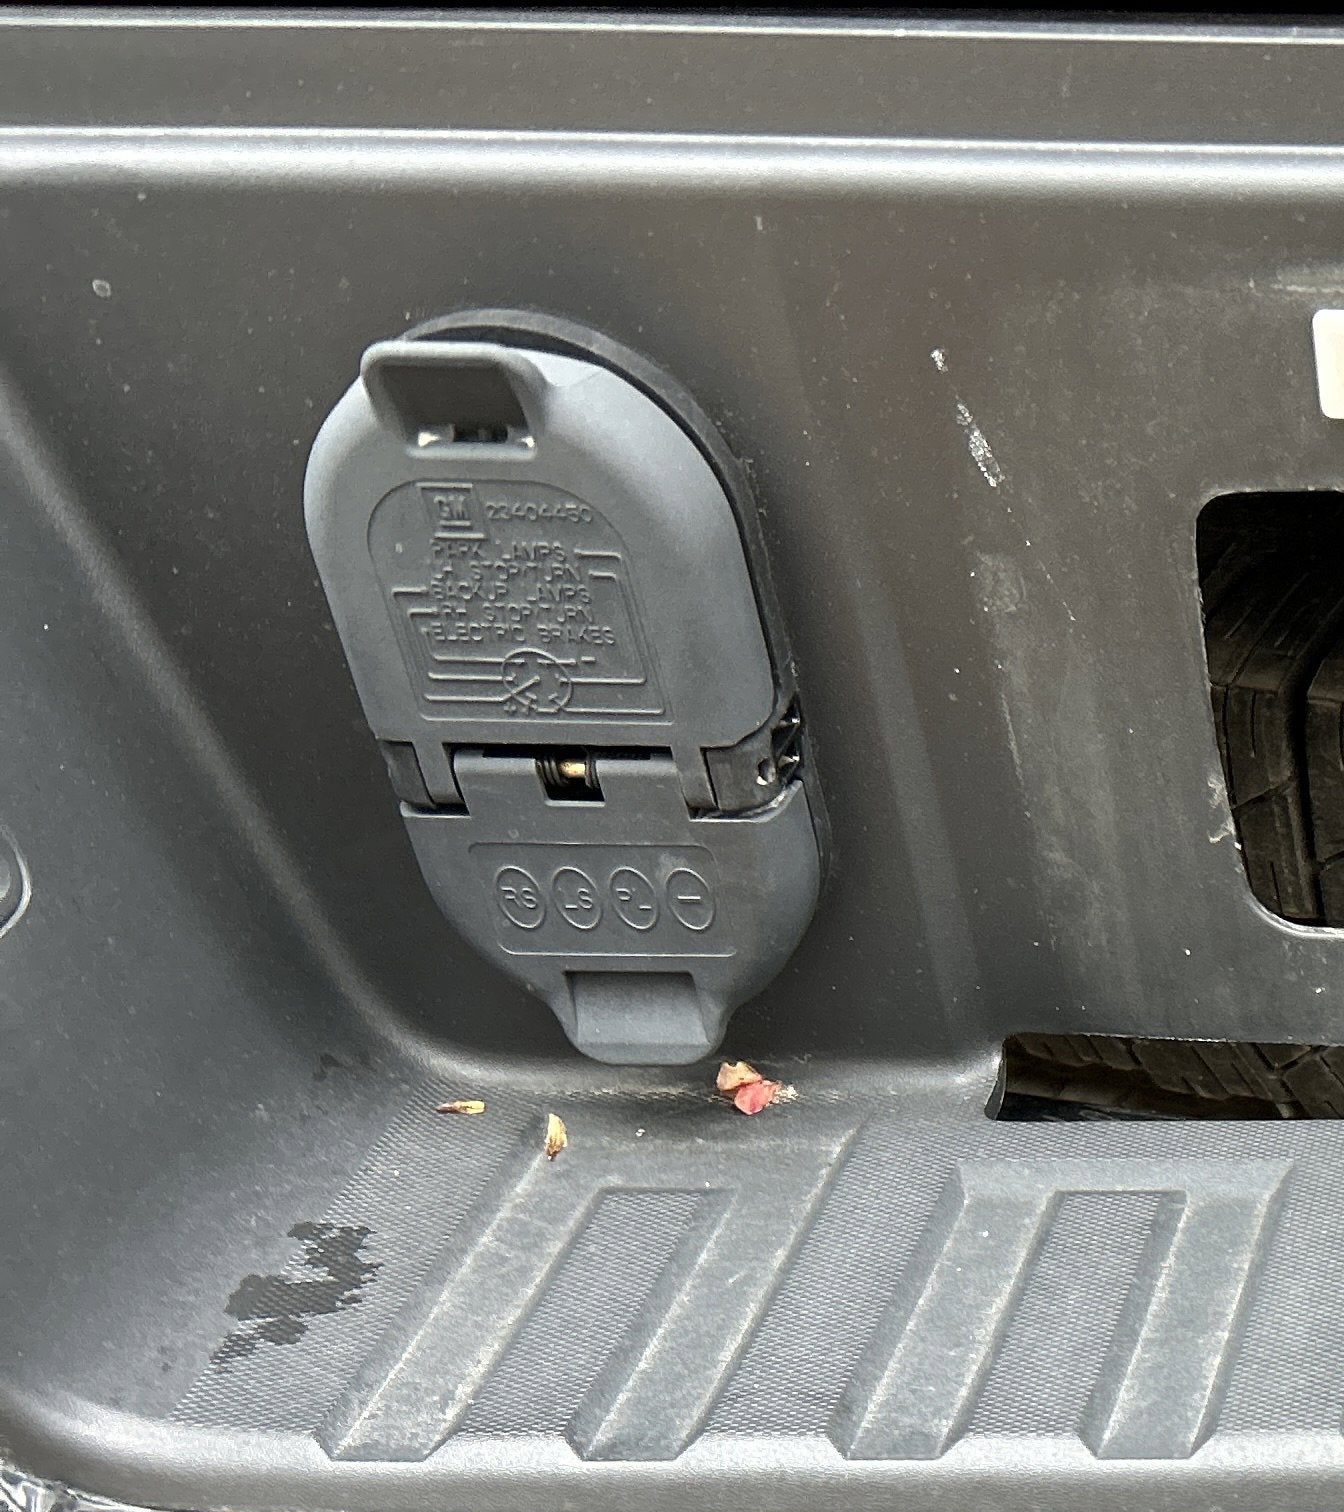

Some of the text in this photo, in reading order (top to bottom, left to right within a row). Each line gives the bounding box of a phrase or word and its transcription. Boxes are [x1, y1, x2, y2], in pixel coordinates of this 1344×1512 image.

[430, 539, 567, 562] PARK LAMPS
[431, 558, 582, 582] LH STOP/TURN
[430, 580, 592, 604] BACKUP LAMPS
[441, 601, 595, 624] RH STOP/TURN
[430, 621, 617, 645] ELECTRIC BRAKES
[500, 886, 537, 910] RS
[556, 886, 594, 910] LS
[615, 886, 653, 910] PL
